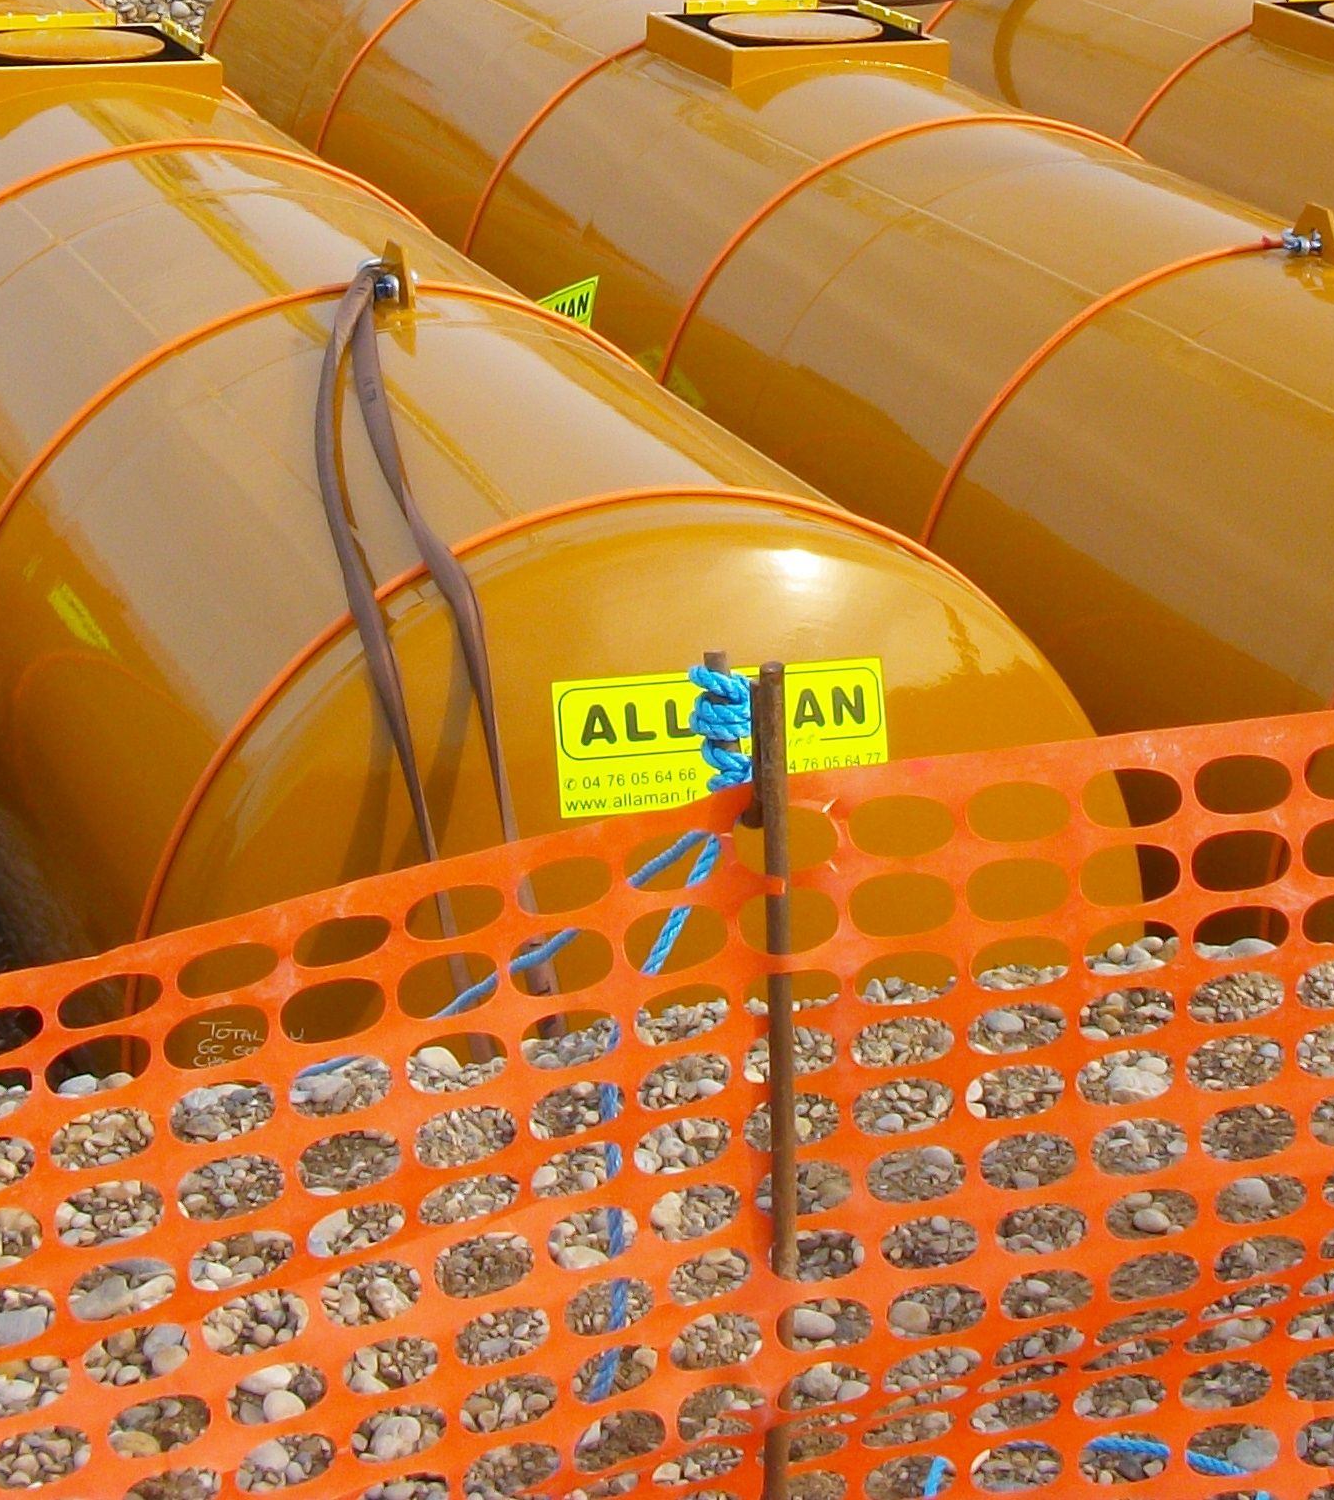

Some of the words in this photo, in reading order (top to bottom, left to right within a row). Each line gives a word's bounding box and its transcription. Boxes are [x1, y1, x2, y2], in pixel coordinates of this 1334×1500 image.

[580, 685, 866, 746] ALLAN
[803, 757, 819, 770] 76
[824, 755, 840, 768] 05
[582, 775, 601, 789] 04
[607, 774, 625, 788] 76
[631, 772, 650, 786] 05
[654, 770, 673, 783] 64
[678, 767, 697, 781] 66
[565, 789, 698, 813] www.allaman.fr
